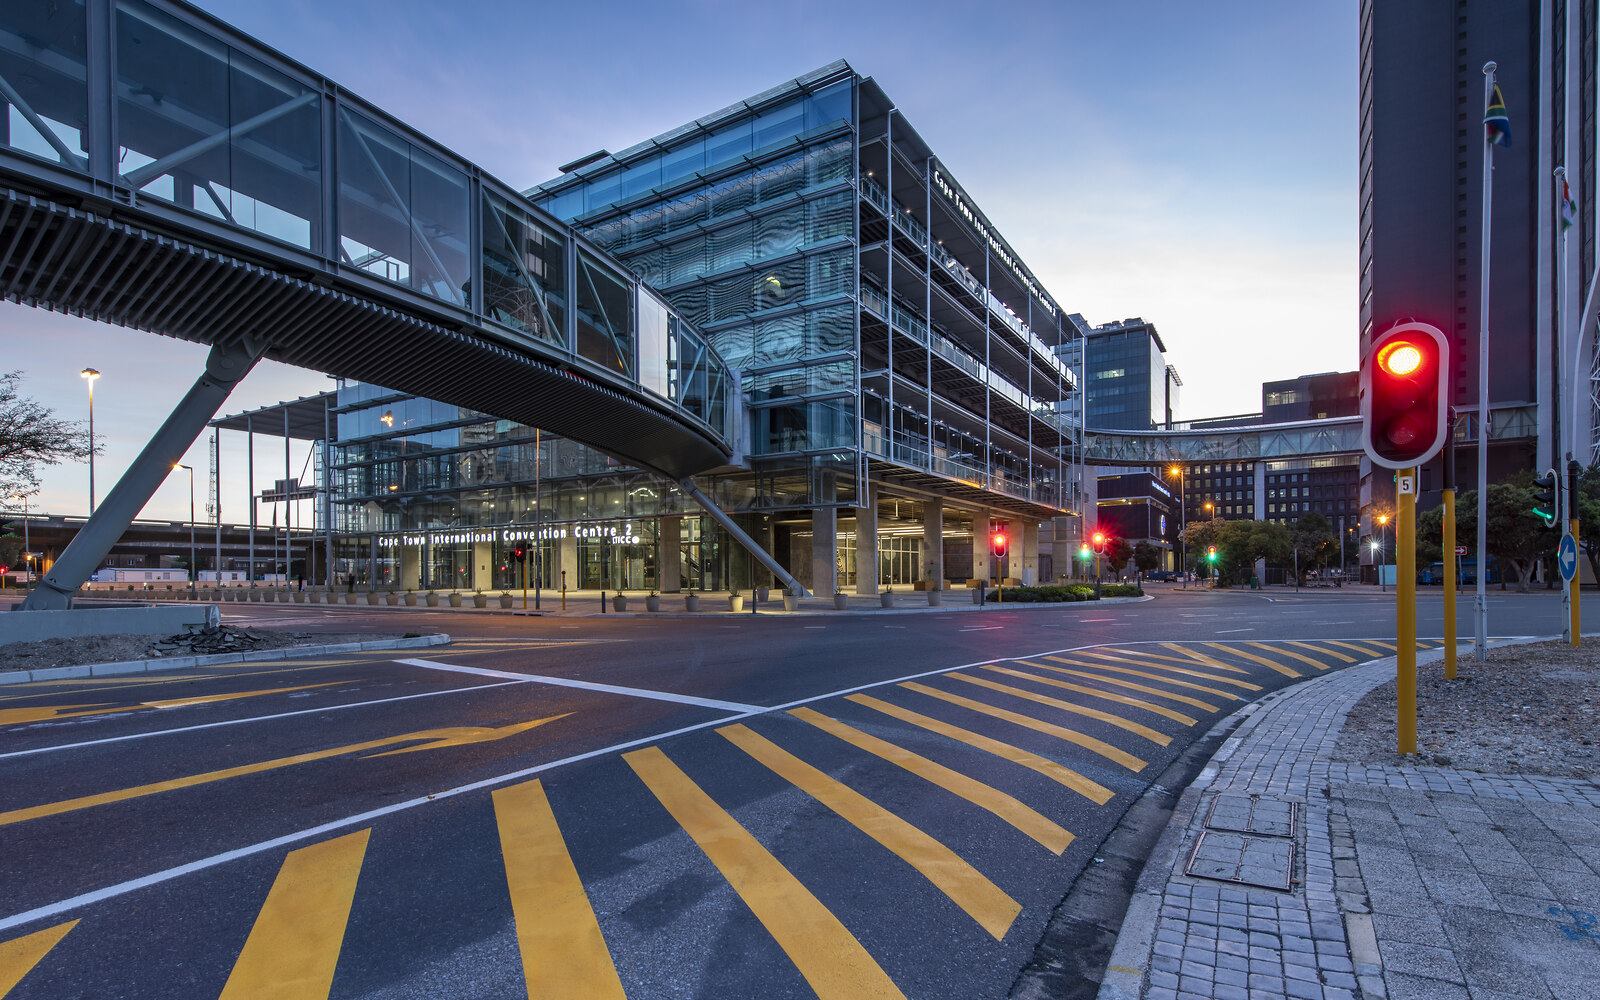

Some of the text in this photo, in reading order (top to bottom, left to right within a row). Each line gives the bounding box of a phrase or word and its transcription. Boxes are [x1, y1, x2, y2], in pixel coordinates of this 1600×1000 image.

[934, 170, 953, 199] Cape
[955, 193, 973, 222] Town
[1402, 478, 1410, 491] 5
[379, 536, 398, 548] Cape
[402, 535, 426, 546] Town
[430, 530, 497, 545] International
[574, 525, 617, 538] Centre
[625, 523, 632, 536] 2
